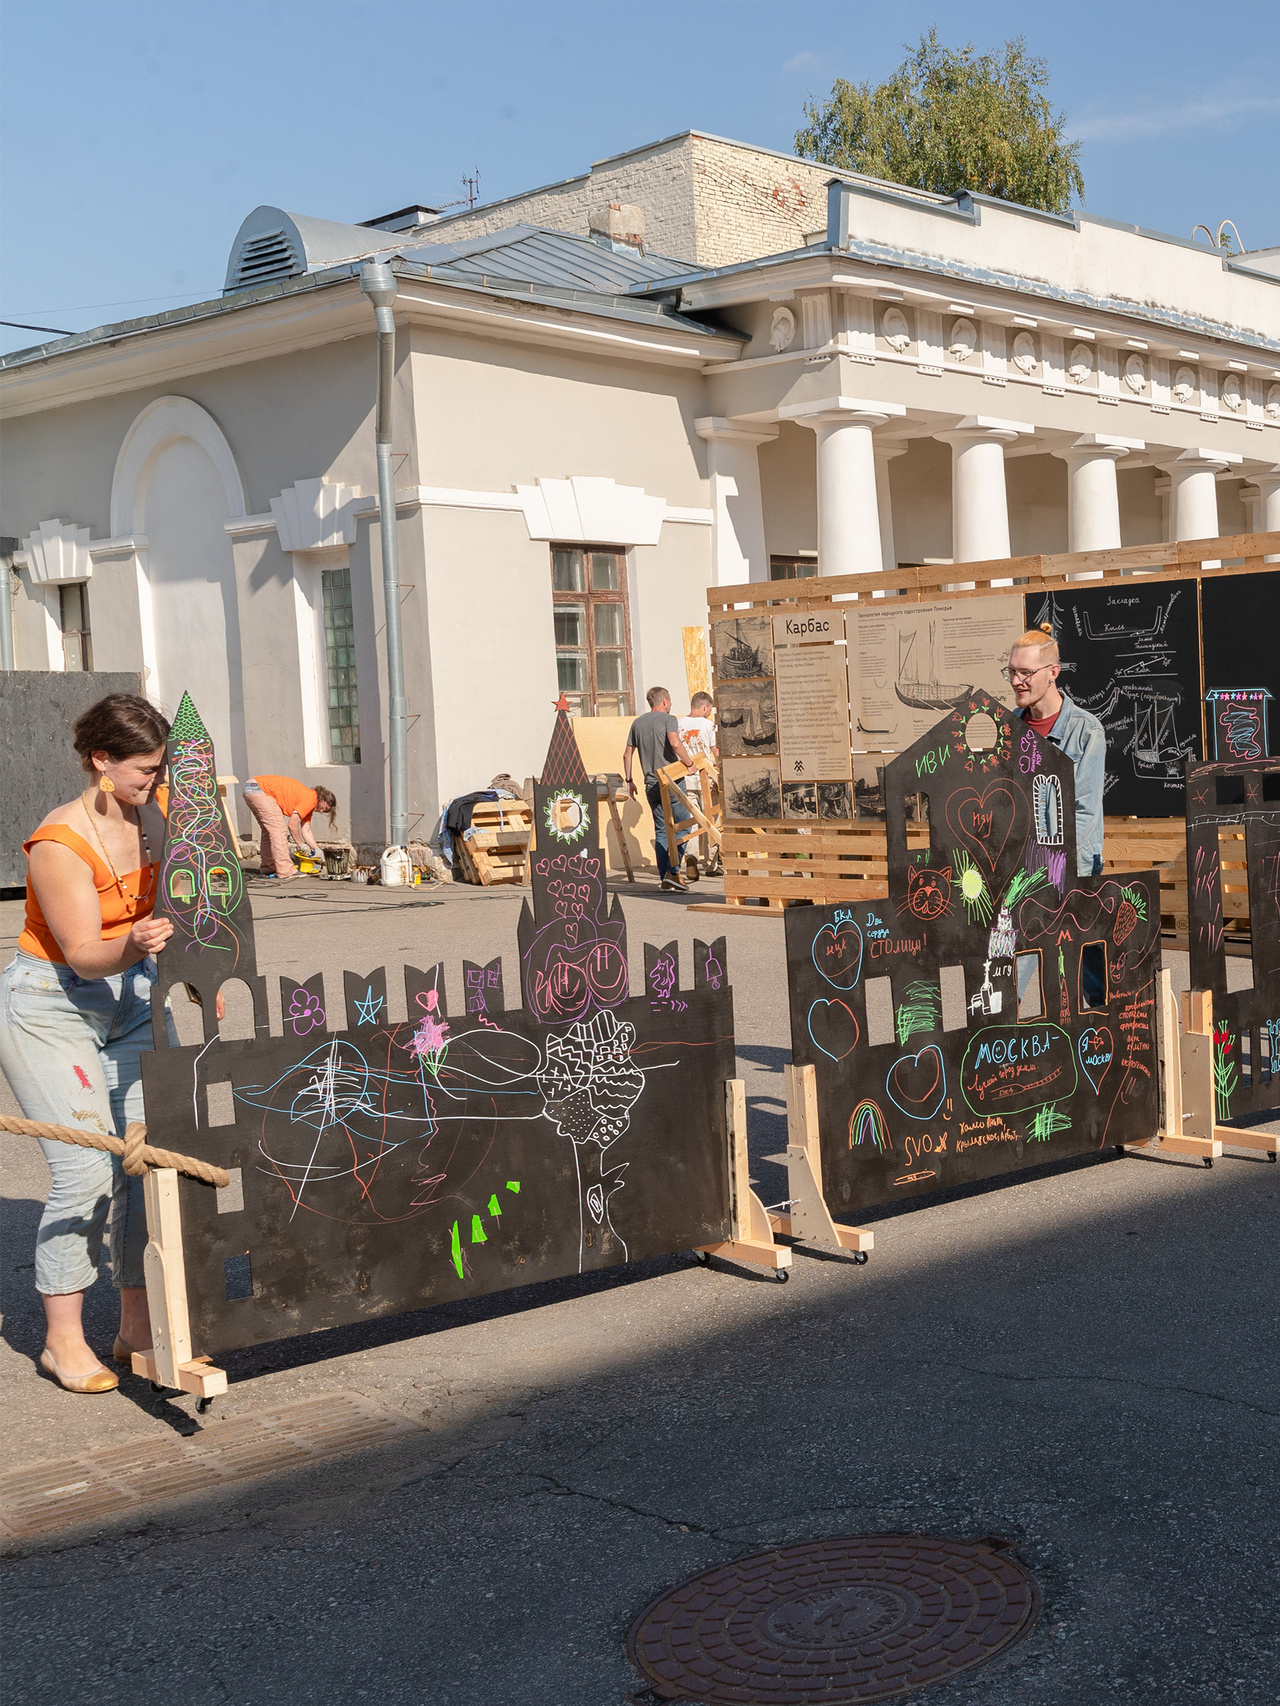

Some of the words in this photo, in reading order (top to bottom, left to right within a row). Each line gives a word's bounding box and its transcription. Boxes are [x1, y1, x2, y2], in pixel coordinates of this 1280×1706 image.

[786, 618, 830, 637] Карбас
[1082, 1036, 1089, 1053] Я
[905, 1134, 932, 1166] SVO
